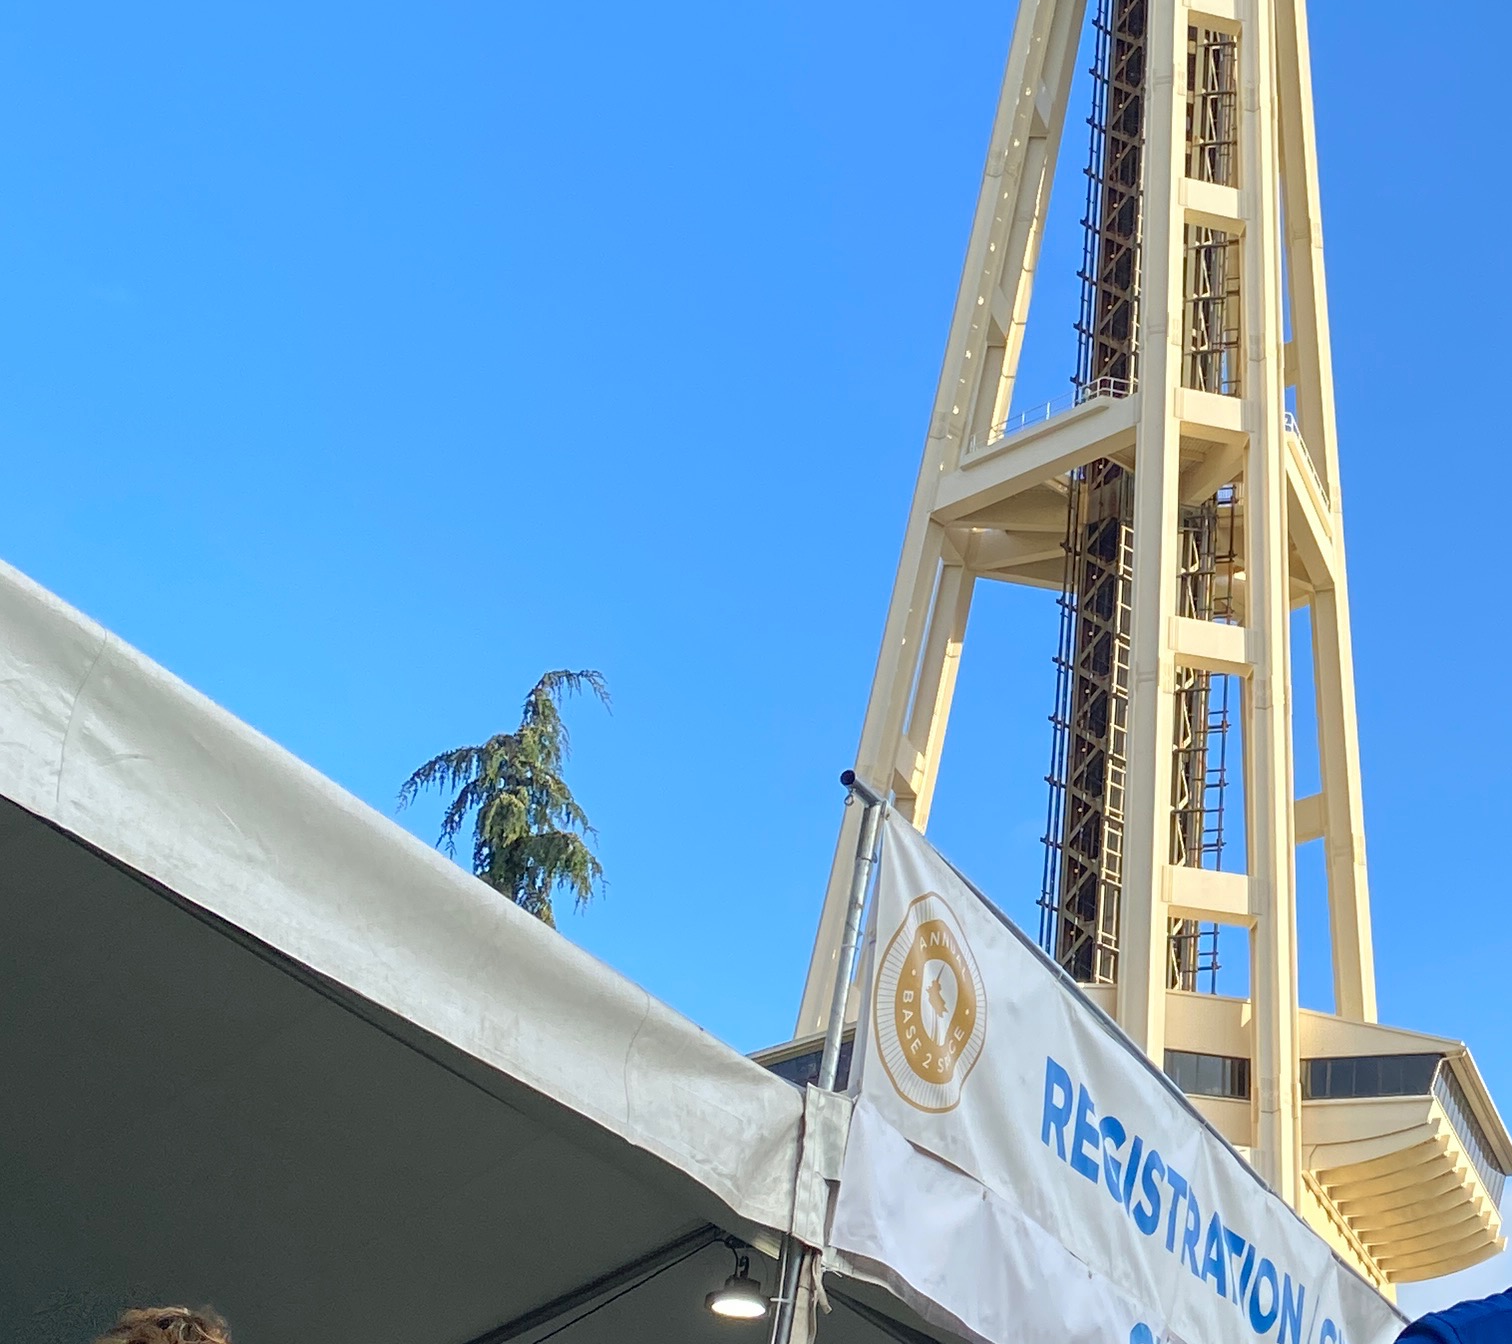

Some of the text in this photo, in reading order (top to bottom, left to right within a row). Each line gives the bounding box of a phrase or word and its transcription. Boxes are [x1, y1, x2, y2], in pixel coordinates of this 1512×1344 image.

[919, 931, 967, 982] ANNUAL
[902, 990, 922, 1055] BASE
[922, 1053, 933, 1069] 2
